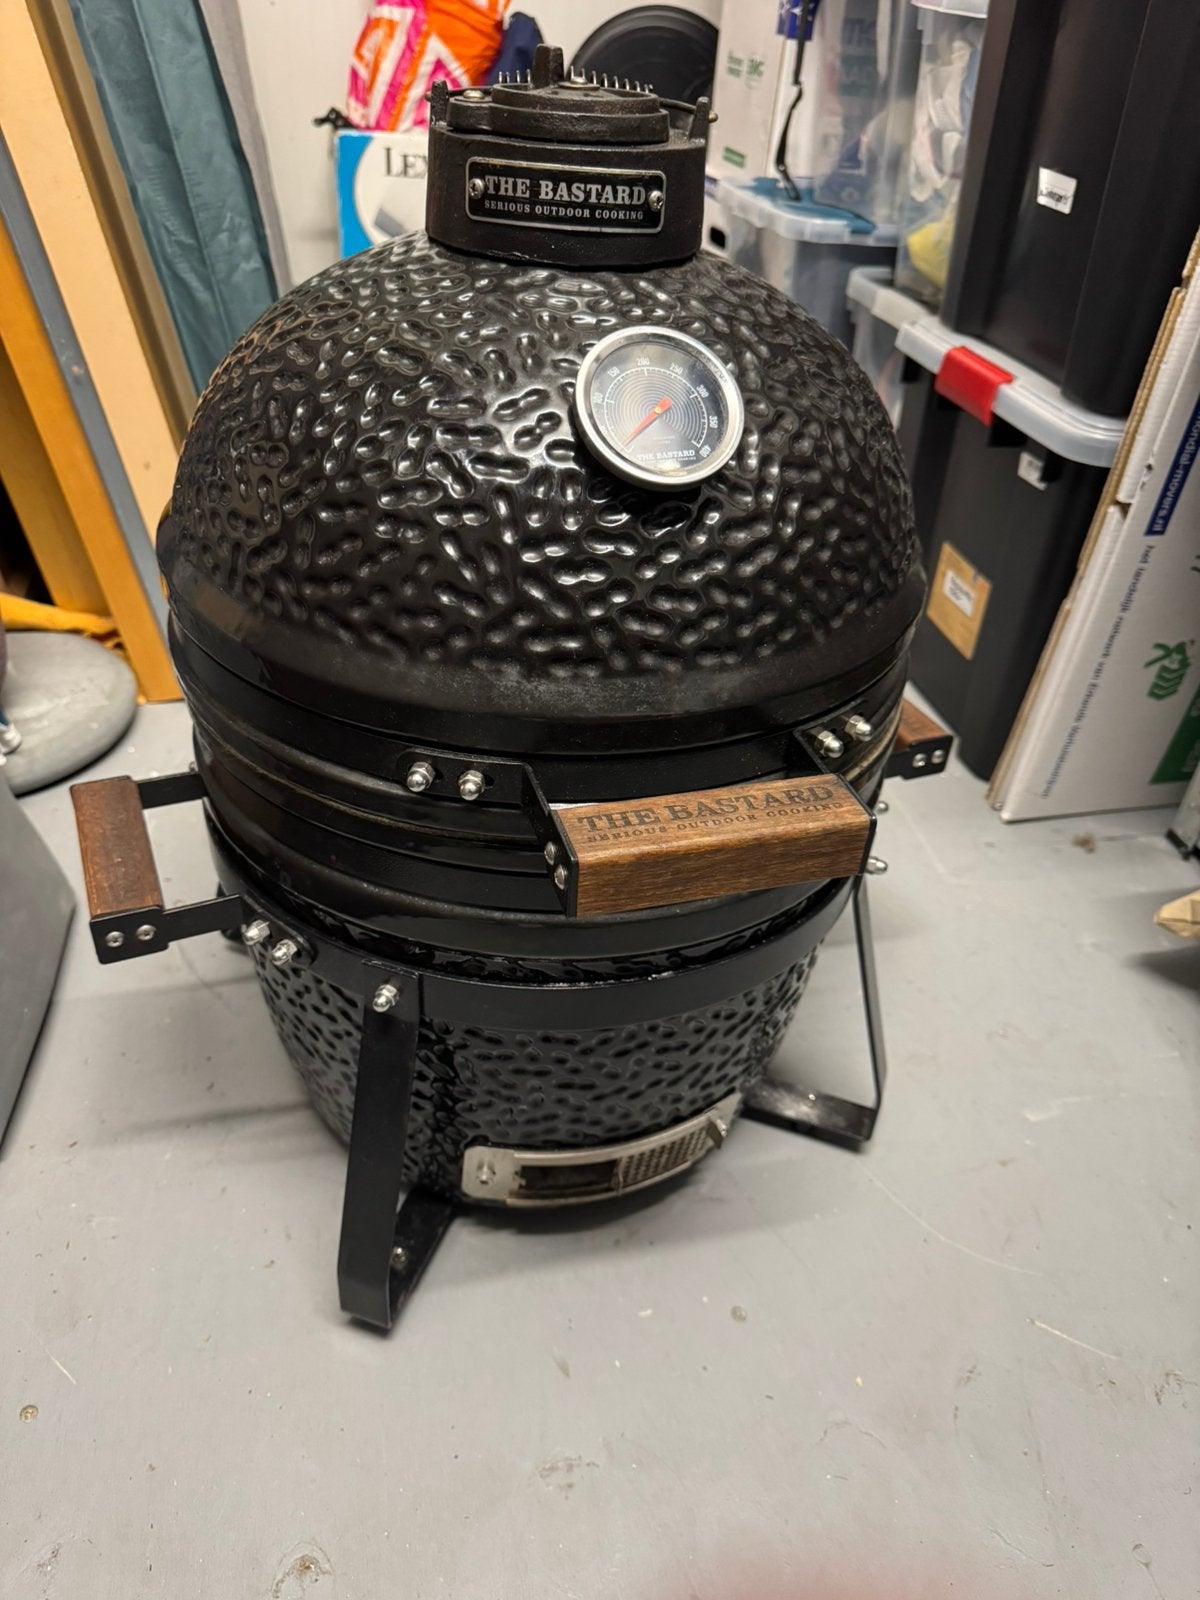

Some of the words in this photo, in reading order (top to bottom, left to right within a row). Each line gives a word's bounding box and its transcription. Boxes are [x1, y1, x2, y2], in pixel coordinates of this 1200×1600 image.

[485, 175, 530, 199] THE
[538, 180, 646, 205] BASTARD
[484, 200, 531, 213] SERIOUS
[535, 205, 590, 218] OUTDOOR
[595, 209, 644, 220] COOKING
[637, 356, 650, 366] 200
[607, 366, 620, 378] 150
[669, 362, 684, 375] 250
[696, 384, 709, 398] 300
[709, 415, 718, 429] 350
[656, 450, 695, 459] BASTARD
[699, 444, 711, 458] 400
[577, 808, 662, 833] THE
[663, 786, 835, 821] BASTARD
[587, 824, 668, 842] SERIOUS
[676, 814, 757, 830] OUTDOOR
[766, 802, 844, 818] COOKING
